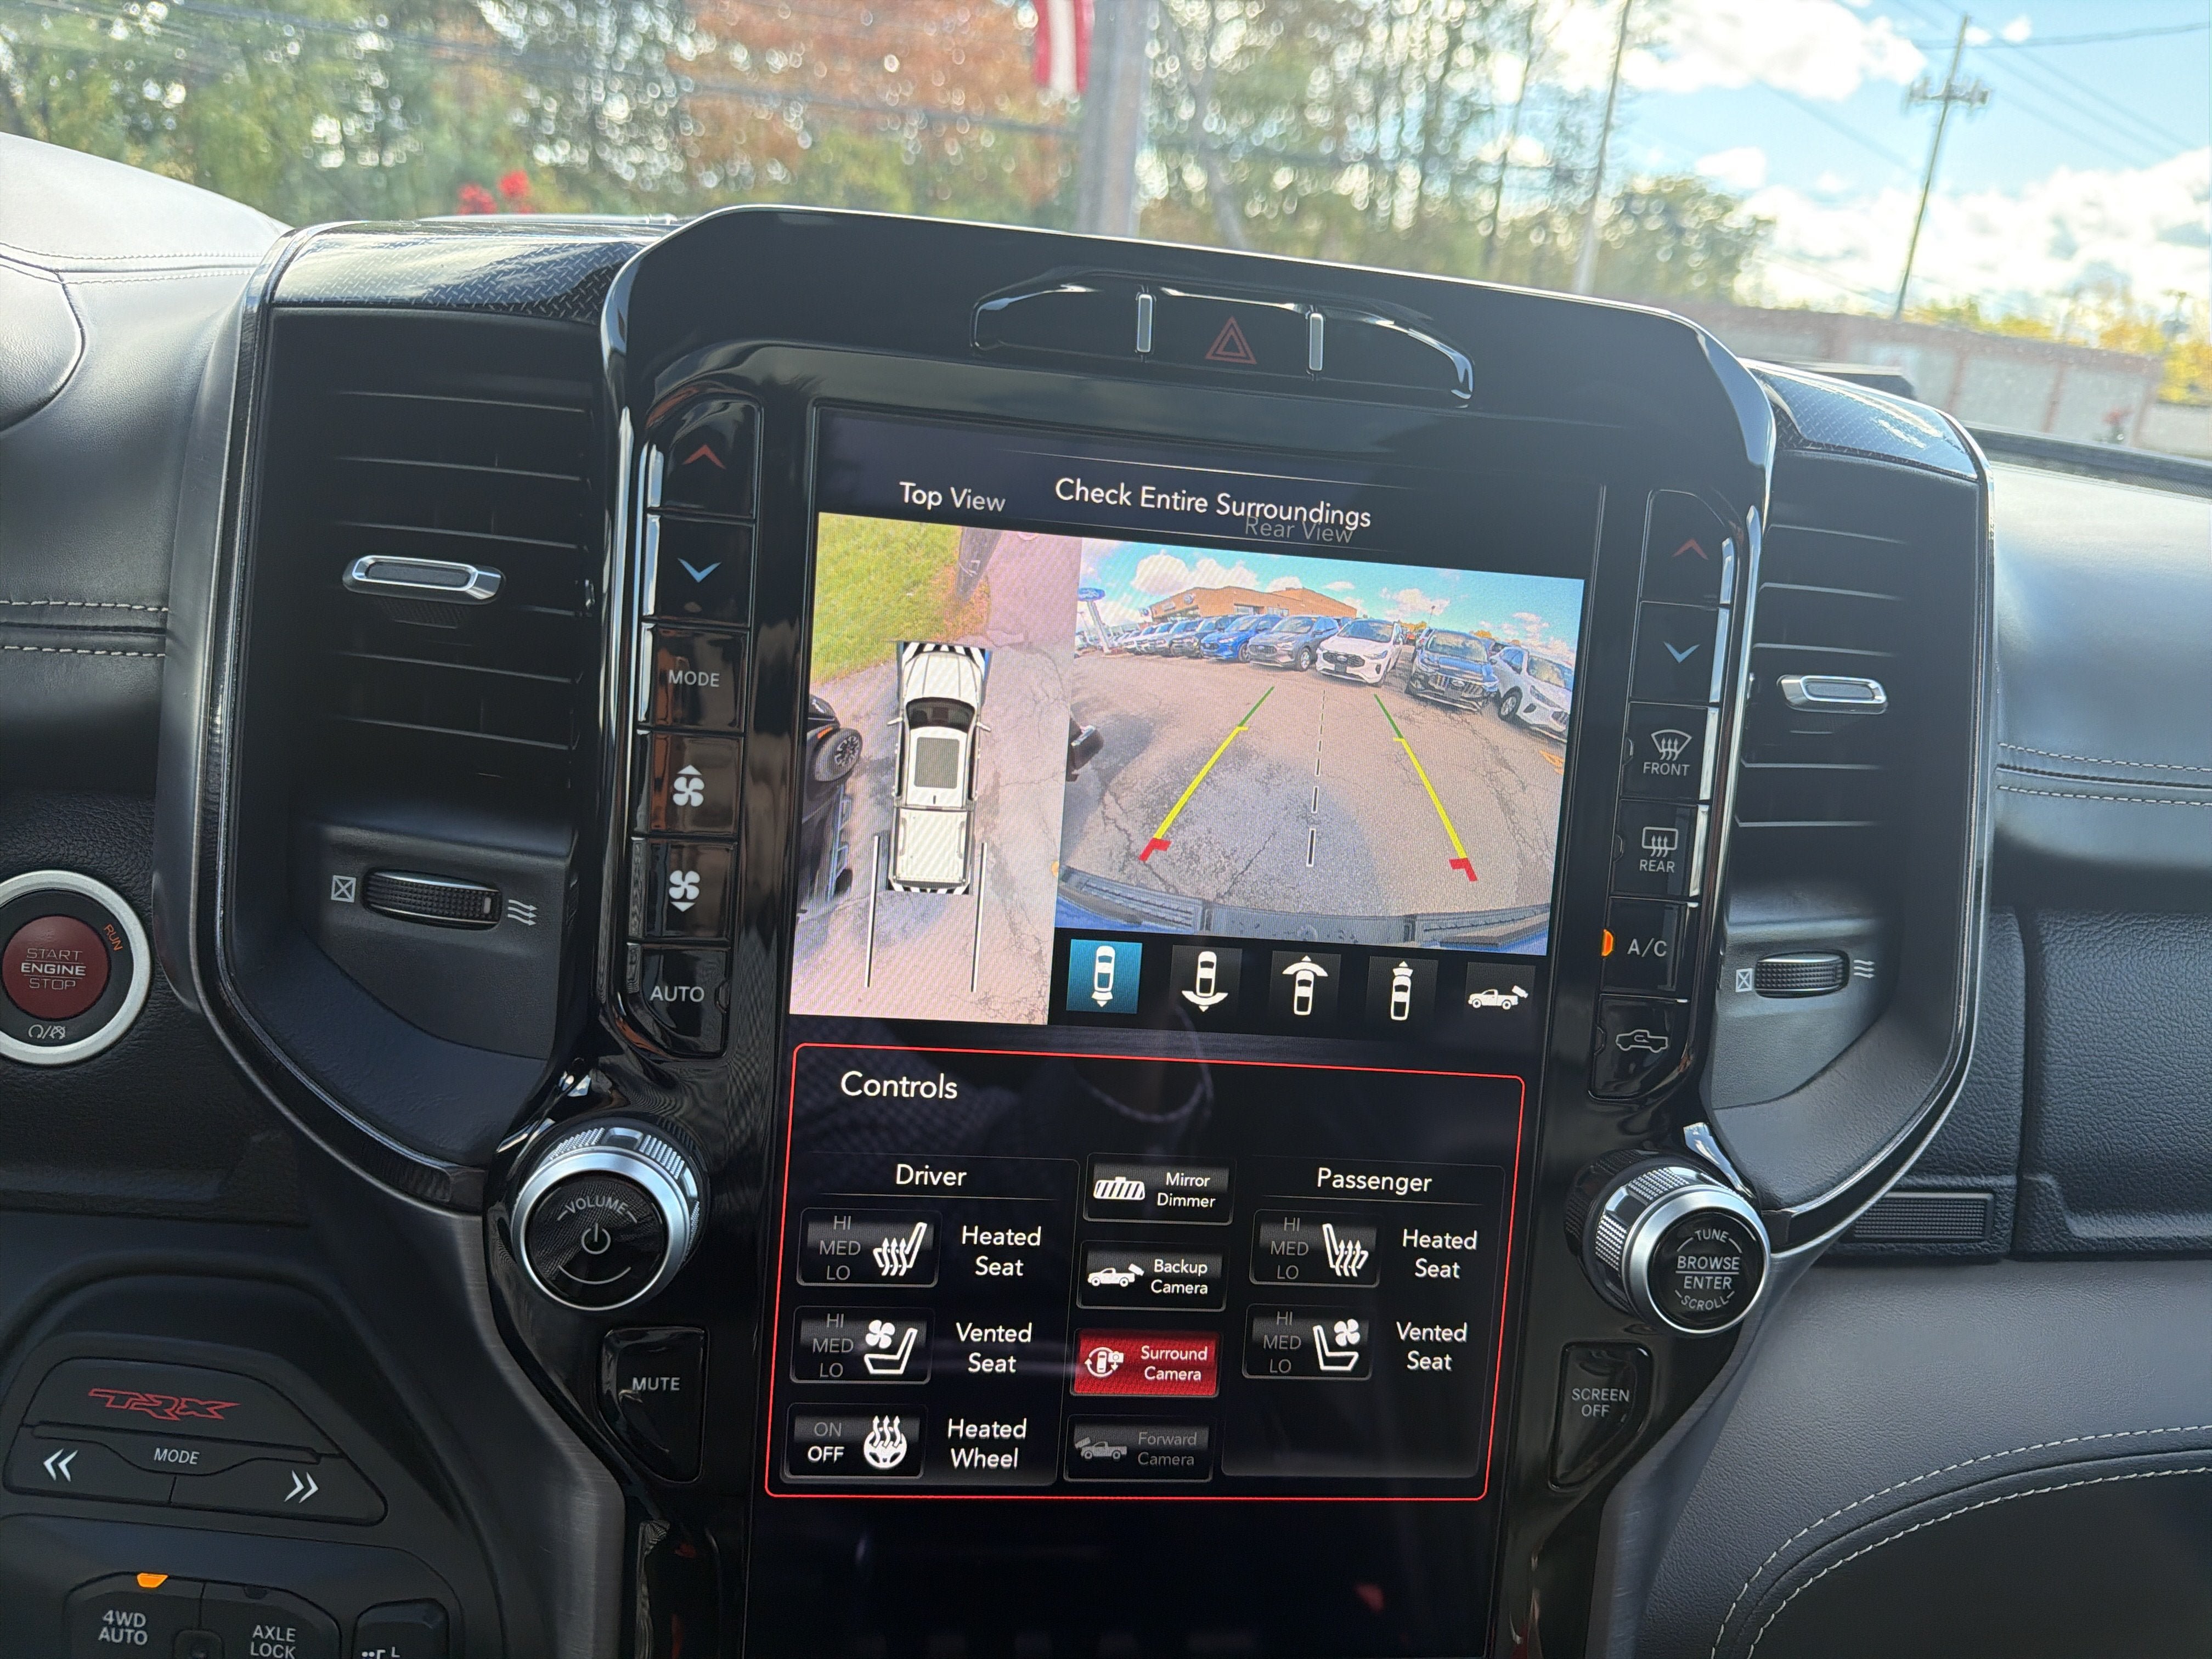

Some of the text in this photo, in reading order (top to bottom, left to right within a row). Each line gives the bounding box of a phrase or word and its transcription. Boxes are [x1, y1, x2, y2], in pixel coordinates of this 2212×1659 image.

[899, 481, 1006, 512] Top View
[1055, 477, 1371, 529] Check Entire Surroundings
[1245, 516, 1354, 544] Rear View
[668, 669, 720, 688] MODE
[1643, 761, 1690, 776] FRONT
[1639, 859, 1675, 874] REAR
[103, 923, 123, 951] RUN
[27, 948, 83, 961] START
[1627, 938, 1668, 957] A/C
[21, 962, 87, 976] ENGINE
[29, 978, 76, 990] STOP
[650, 985, 705, 1003] AUTO
[841, 1070, 958, 1099] Controls
[896, 1164, 967, 1187] Driver
[1166, 1172, 1210, 1188] Mirror
[1317, 1167, 1432, 1195] Passenger
[566, 1195, 628, 1214] VOLUME
[1157, 1193, 1216, 1208] Dimmer
[833, 1215, 852, 1231] HI
[1284, 1217, 1300, 1232] HI
[961, 1225, 1042, 1247] Heated
[1402, 1228, 1478, 1251] Heated
[1694, 1228, 1729, 1244] TUNE
[819, 1240, 861, 1256] MED
[1270, 1241, 1309, 1256] MED
[975, 1256, 1024, 1277] Seat
[1154, 1259, 1208, 1276] Backup
[1415, 1258, 1461, 1279] Seat
[1677, 1255, 1740, 1271] BROWSE
[826, 1265, 851, 1280] LO
[1277, 1265, 1299, 1280] LO
[1151, 1279, 1208, 1295] Camera
[1683, 1276, 1733, 1290] ENTER
[1680, 1295, 1730, 1312] SCROLL
[826, 1313, 844, 1328] HI
[1276, 1311, 1293, 1325] HI
[956, 1322, 1032, 1344] Vented
[1396, 1322, 1468, 1343] Vented
[812, 1338, 854, 1353] MED
[1263, 1335, 1301, 1350] MED
[1141, 1345, 1208, 1361] Surround
[1407, 1350, 1453, 1371] Seat
[819, 1363, 843, 1378] LO
[968, 1352, 1016, 1373] Seat
[1269, 1359, 1292, 1374] LO
[1144, 1366, 1201, 1382] Camera
[631, 1377, 681, 1391] MUTE
[1571, 1388, 1630, 1403] SCREEN
[88, 1388, 241, 1421] TRX
[1581, 1404, 1610, 1418] OFF
[814, 1422, 842, 1437] ON
[947, 1417, 1028, 1440] Heated
[1138, 1431, 1197, 1446] Forward
[154, 1447, 200, 1465] MODE
[808, 1446, 844, 1463] OFF
[950, 1447, 1018, 1469] Wheel
[1138, 1452, 1194, 1466] Camera
[101, 1610, 146, 1628] 4WD
[98, 1626, 148, 1646] AUTO
[252, 1624, 296, 1643] AXLE
[250, 1641, 297, 1659] LOCK
